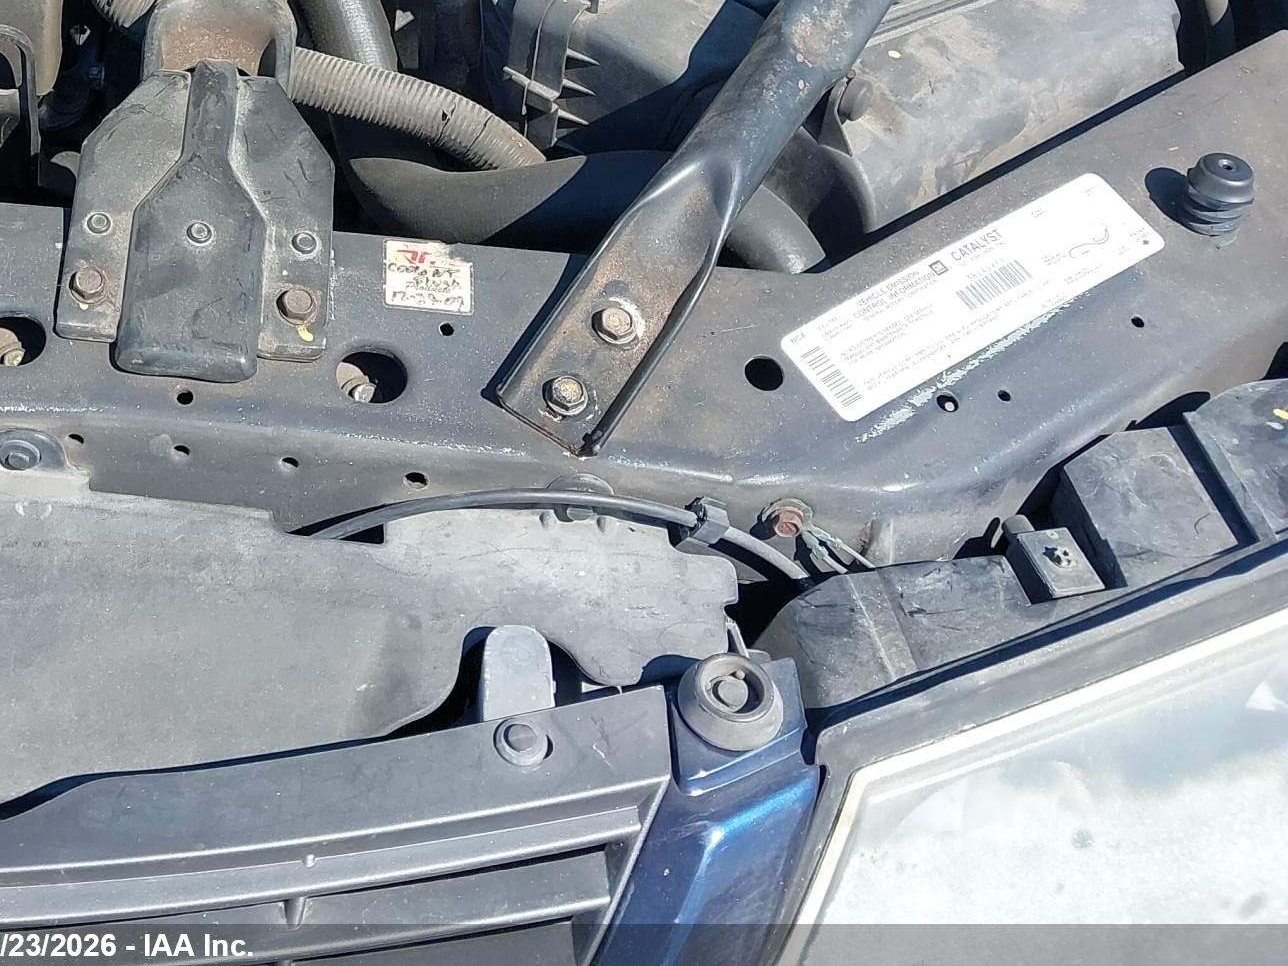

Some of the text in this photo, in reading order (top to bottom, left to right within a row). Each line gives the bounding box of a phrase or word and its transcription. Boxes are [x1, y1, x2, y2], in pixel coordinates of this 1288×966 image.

[950, 228, 1002, 261] CATALYST
[853, 271, 937, 318] CONTROL INFORMATION
